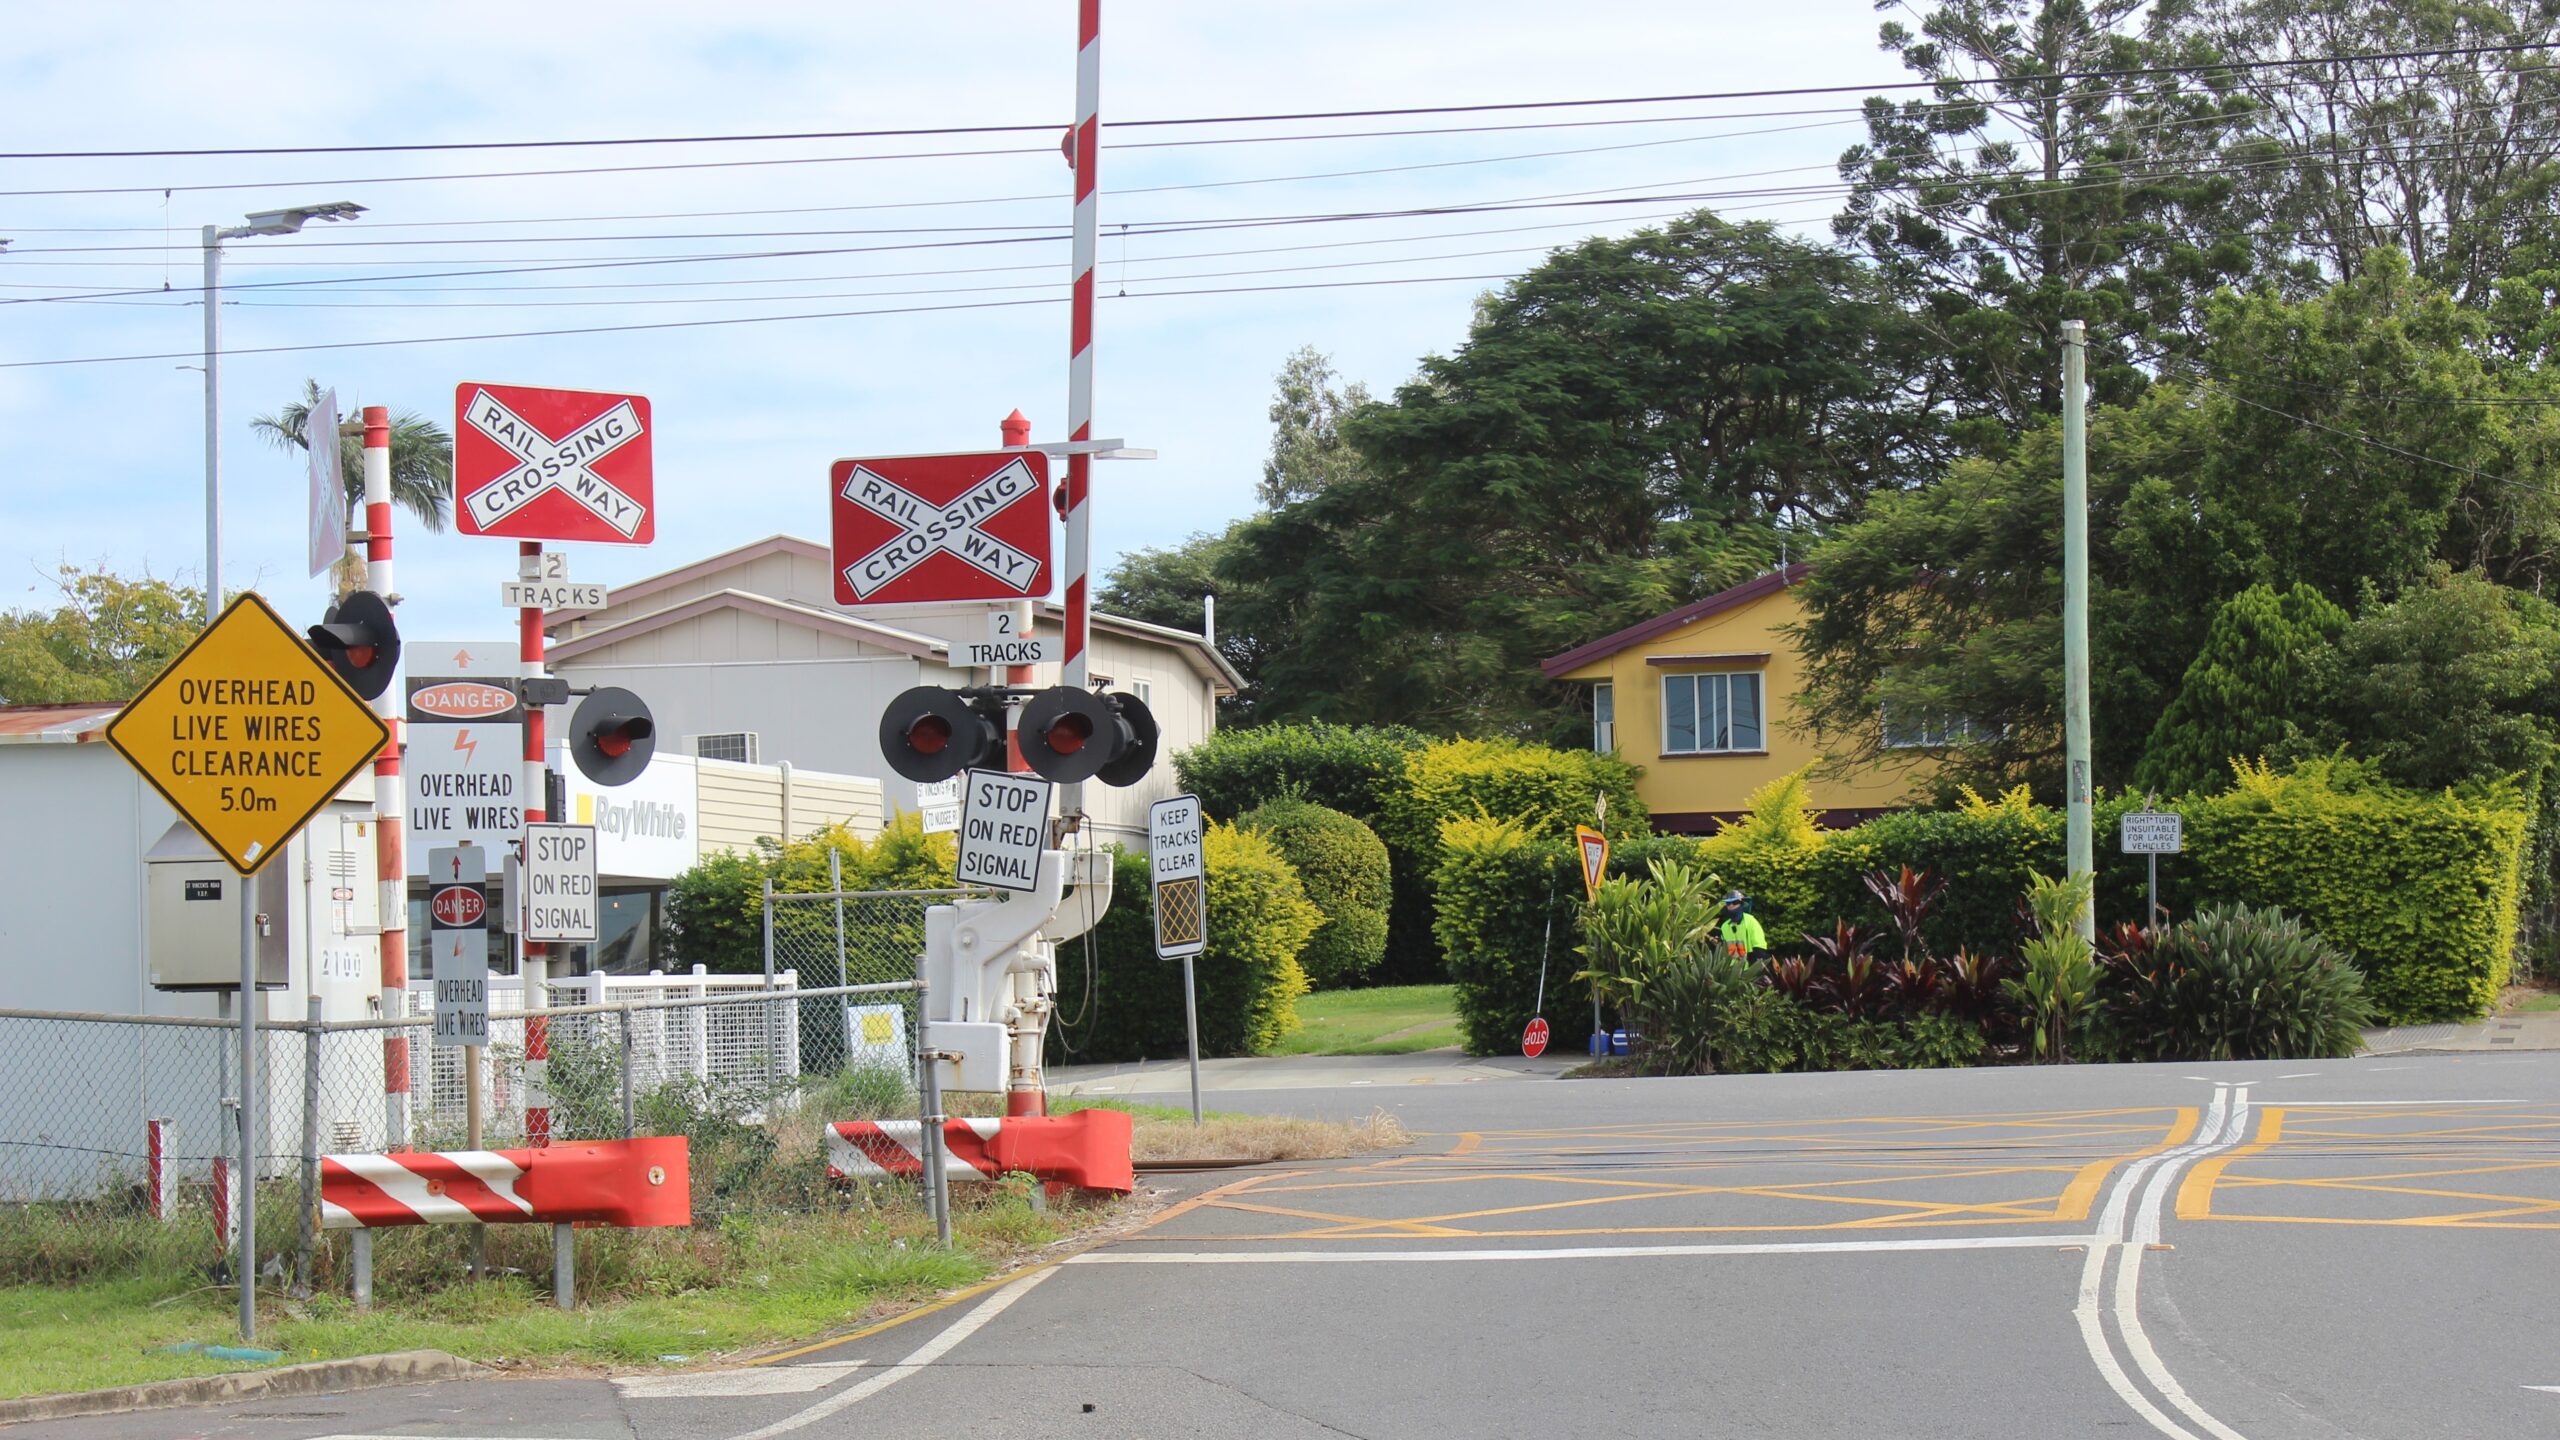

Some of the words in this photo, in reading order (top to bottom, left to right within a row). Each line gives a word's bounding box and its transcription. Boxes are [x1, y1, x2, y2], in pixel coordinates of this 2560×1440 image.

[483, 406, 536, 460] RAIL
[576, 474, 630, 519] WAY
[485, 418, 624, 512] CROSSING
[862, 480, 920, 526] RAIL
[964, 534, 1025, 575] WAY
[865, 476, 1017, 581] CROSSING
[546, 557, 562, 578] 2
[510, 587, 600, 605] TRACKS
[998, 614, 1010, 634] 2
[969, 642, 1042, 663] TRACKS
[180, 679, 315, 705] OVERHEAD
[424, 693, 505, 708] DANGER
[173, 715, 228, 741] LIVE
[244, 716, 321, 742] WIRES
[172, 750, 322, 777] CLEARANCE
[420, 773, 512, 797] OVERHEAD
[220, 786, 277, 812] 5.0m
[979, 783, 1038, 813] STOP
[414, 807, 451, 830] LIVE
[466, 807, 519, 830] WIRES
[1161, 808, 1189, 827] KEEP
[2126, 825, 2177, 833] UNSUITABLE
[969, 819, 994, 841] ON
[1000, 823, 1038, 847] RED
[1154, 830, 1198, 850] TRACKS
[538, 836, 586, 861] STOP
[2132, 842, 2172, 850] VEHICLES
[965, 851, 1031, 880] SIGNAL
[1159, 853, 1195, 872] CLEAR
[533, 874, 554, 895] ON
[561, 874, 592, 896] RED
[437, 899, 480, 914] DANGER
[535, 908, 592, 929] SIGNAL
[322, 950, 361, 978] 2100
[438, 979, 483, 1003] OVERHEAD
[437, 1013, 455, 1036] LIVE
[459, 1011, 486, 1036] WIRES
[1524, 1031, 1547, 1046] STOP
